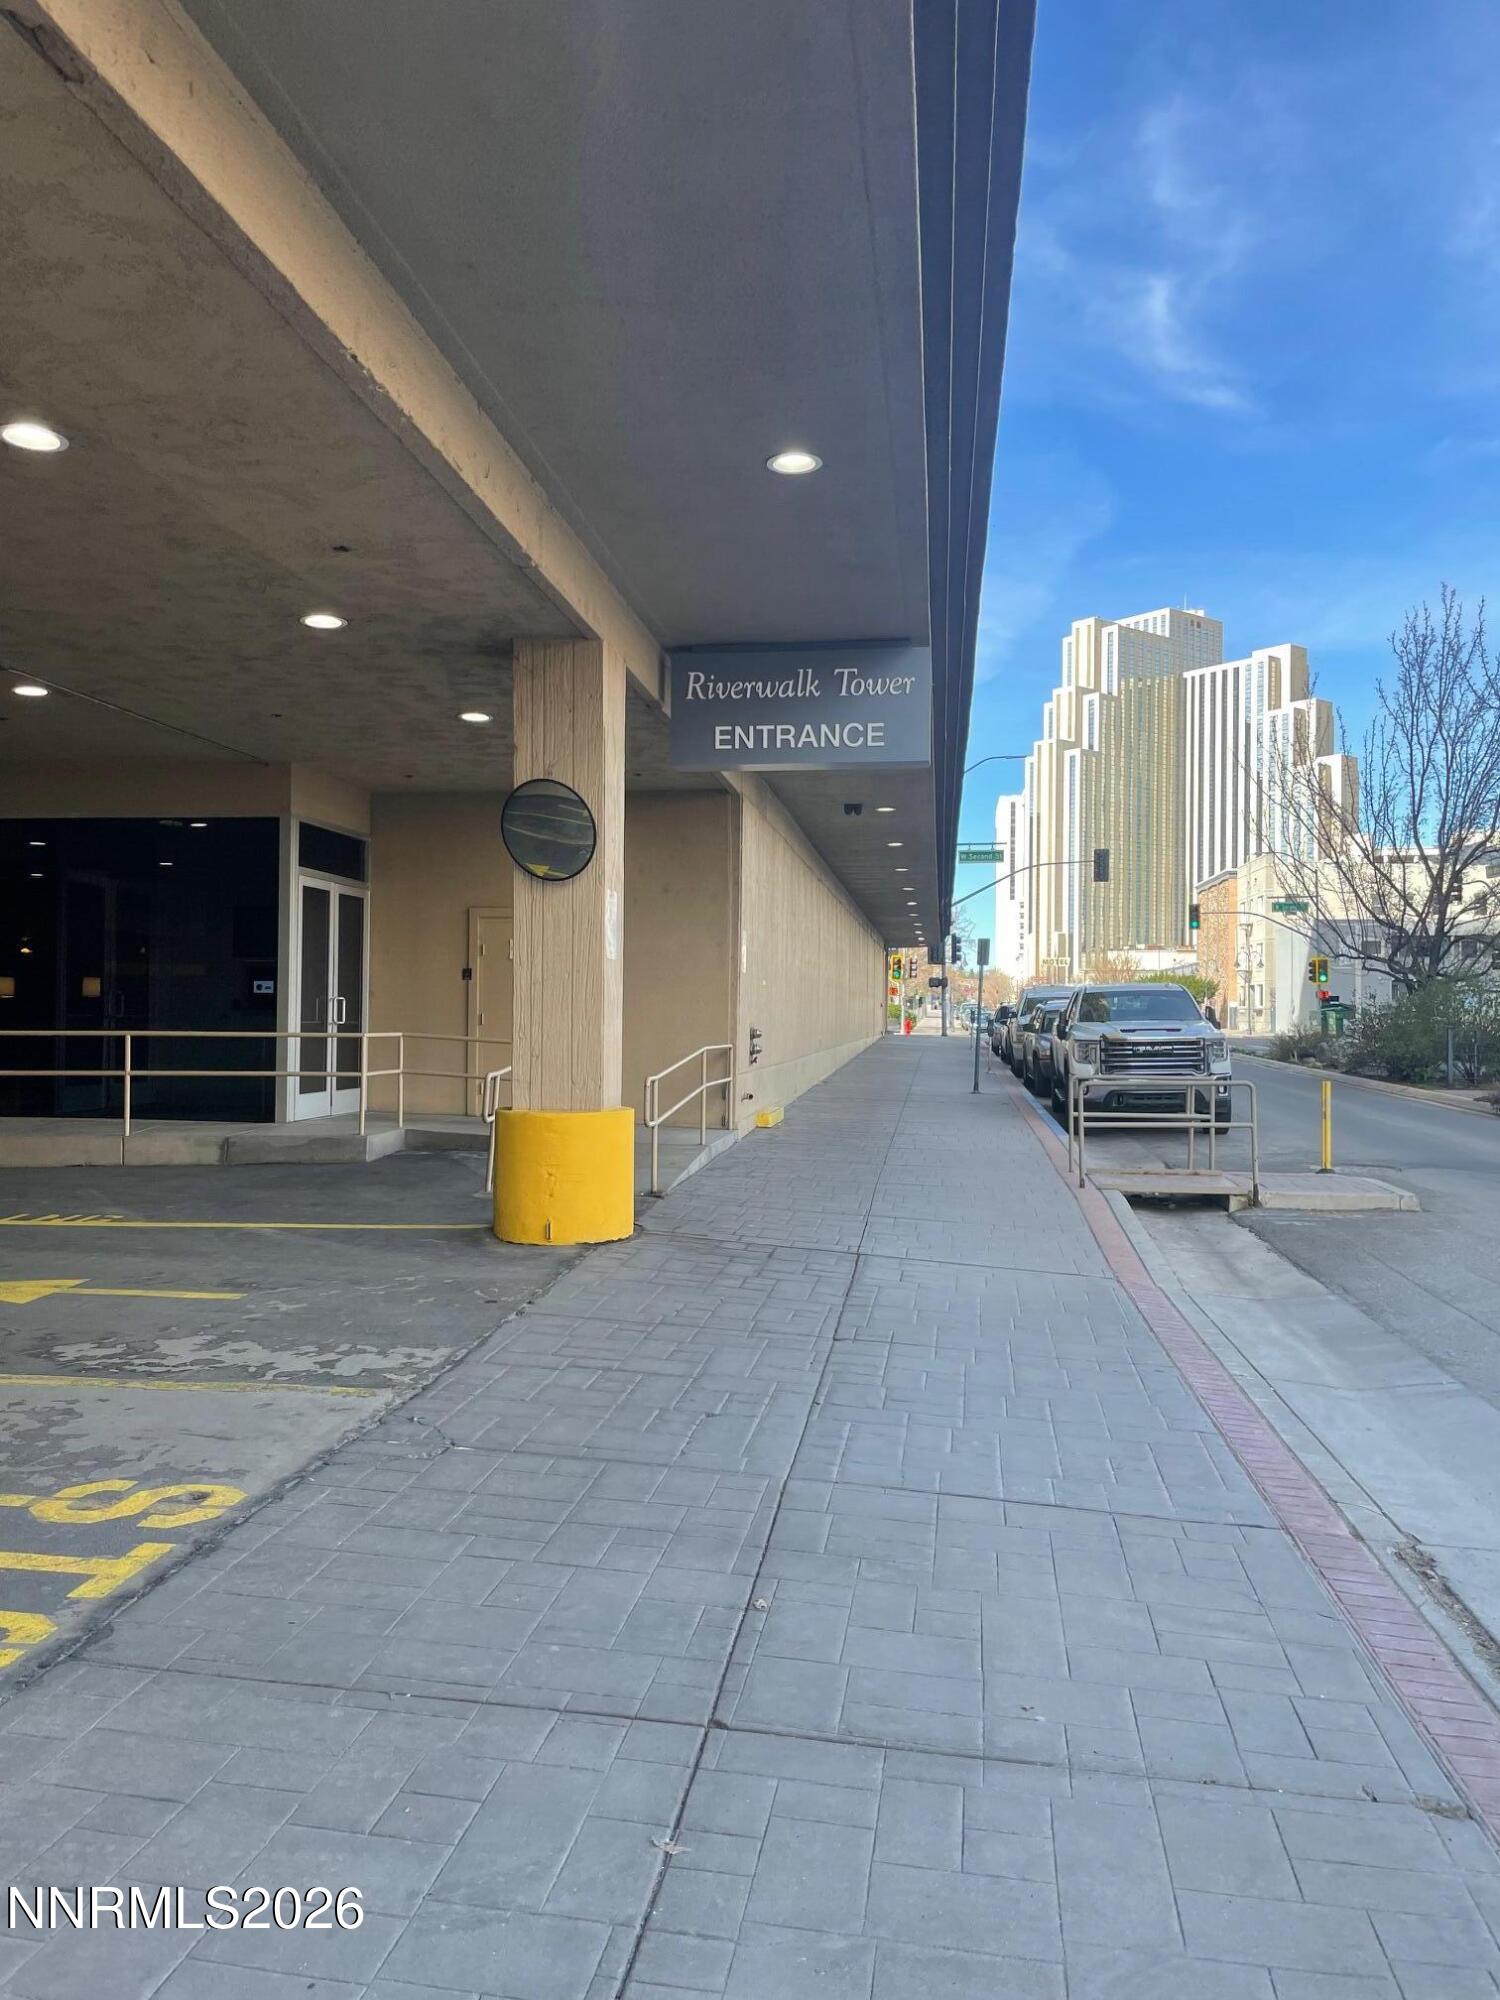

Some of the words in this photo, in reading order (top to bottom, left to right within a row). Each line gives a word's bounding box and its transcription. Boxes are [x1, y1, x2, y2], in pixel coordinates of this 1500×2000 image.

[685, 669, 821, 700] Riverwalk
[834, 667, 916, 697] Tower
[714, 722, 885, 750] ENTRANCE
